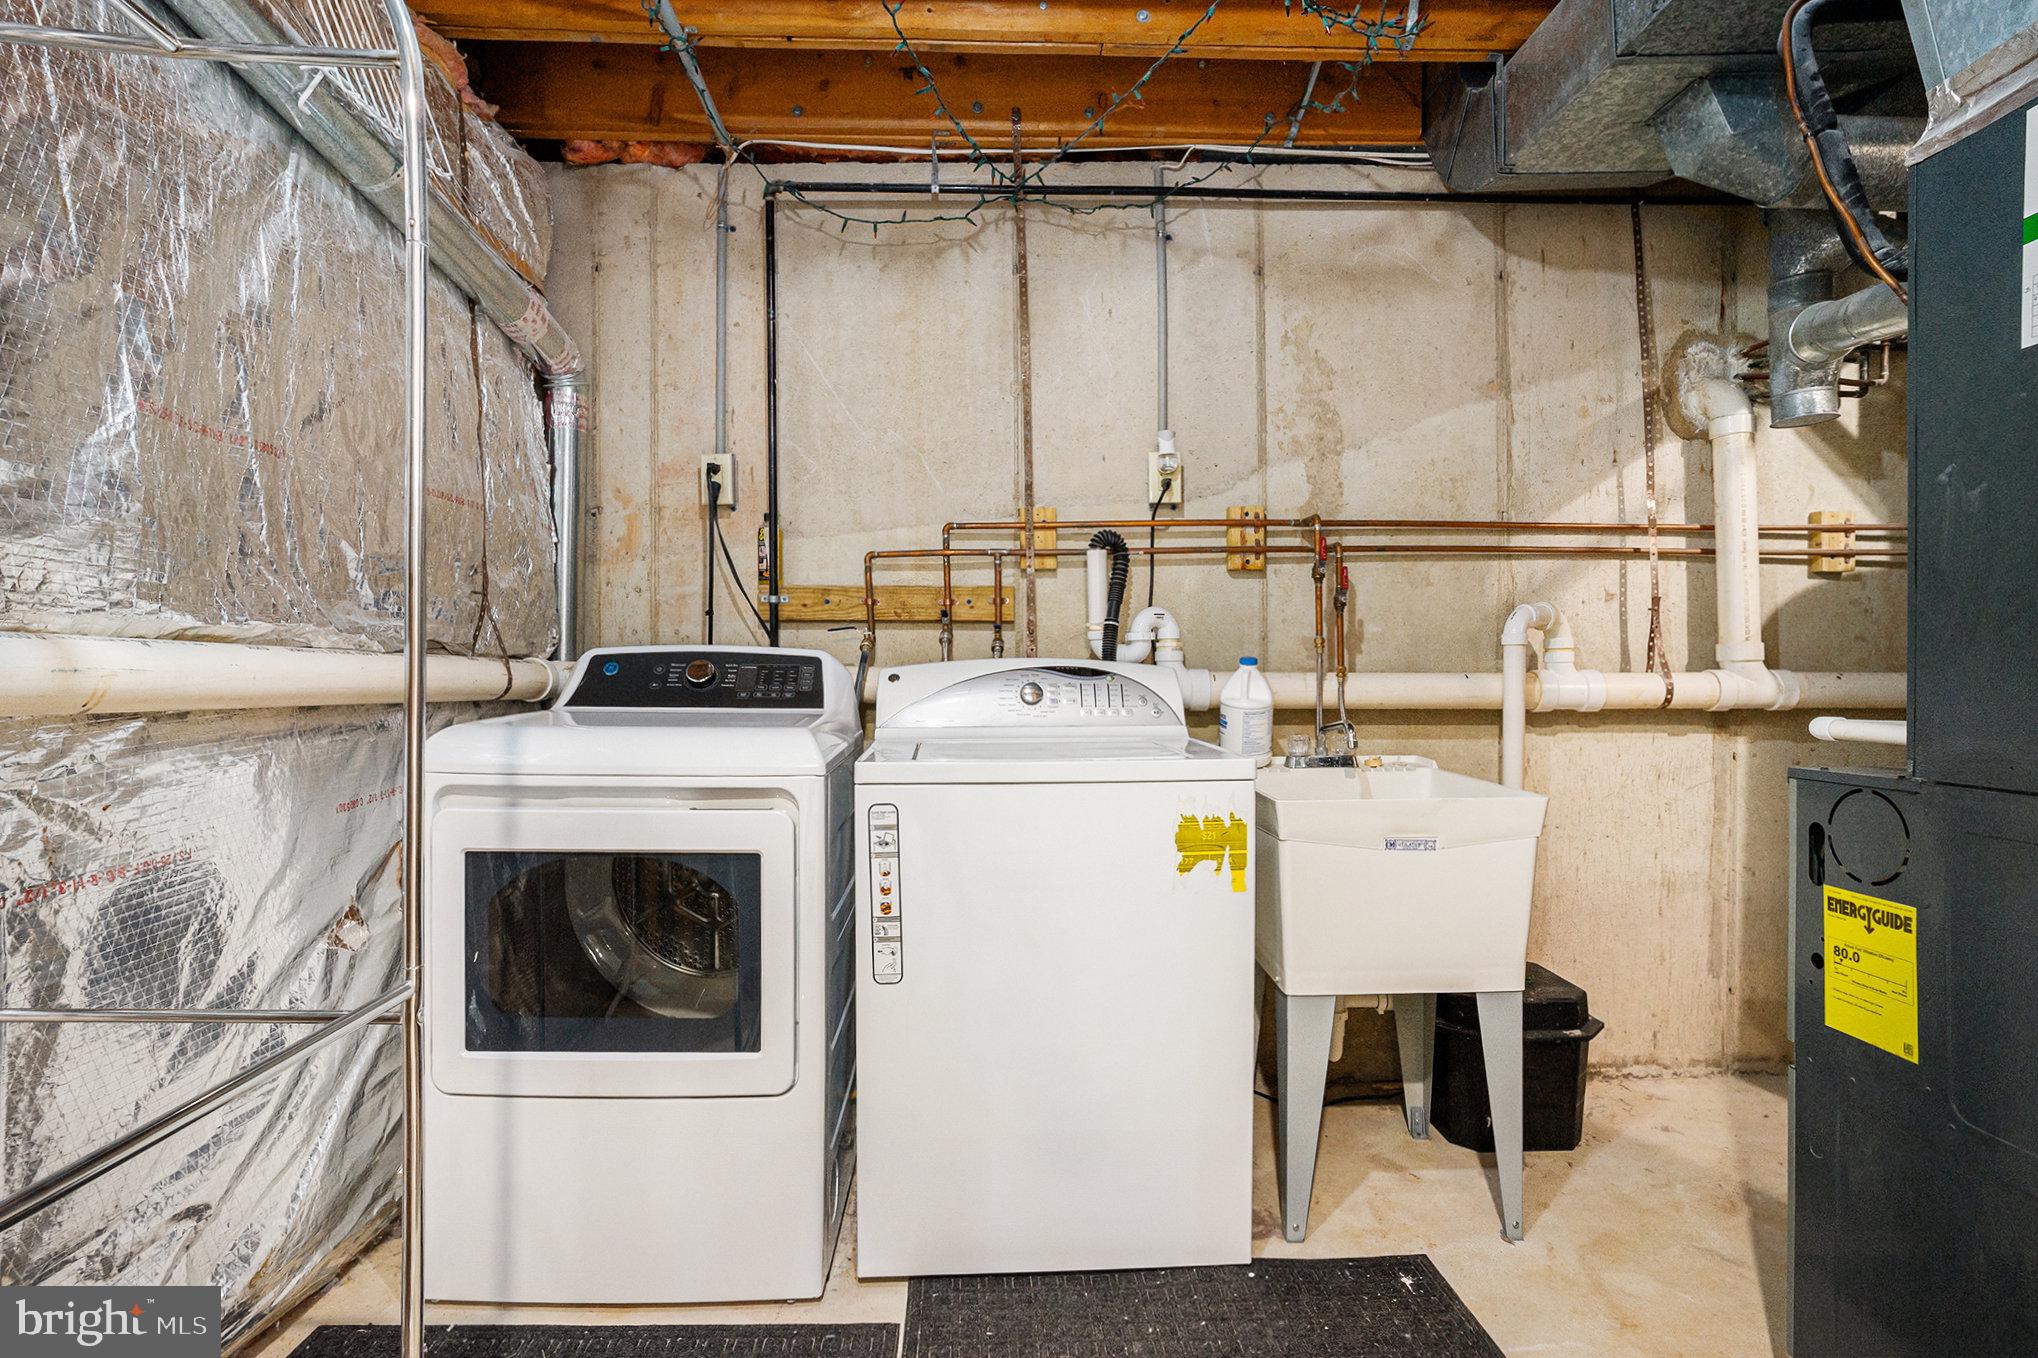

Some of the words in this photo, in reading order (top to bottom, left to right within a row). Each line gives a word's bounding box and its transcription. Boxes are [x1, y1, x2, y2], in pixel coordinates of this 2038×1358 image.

[1201, 831, 1217, 840] $21
[1827, 896, 1913, 934] ENERGYGUIDE
[1833, 945, 1860, 963] 80.0
